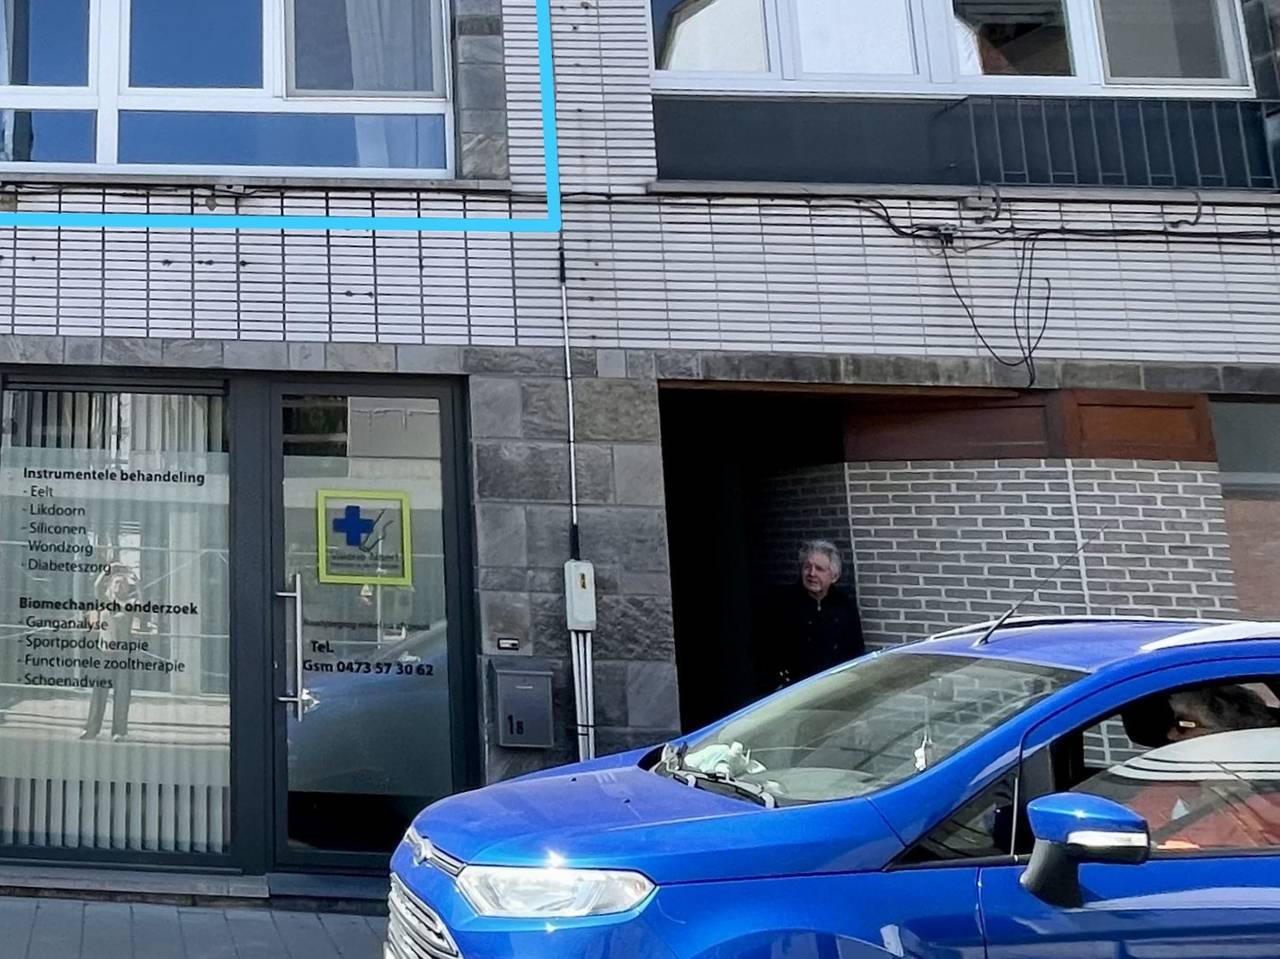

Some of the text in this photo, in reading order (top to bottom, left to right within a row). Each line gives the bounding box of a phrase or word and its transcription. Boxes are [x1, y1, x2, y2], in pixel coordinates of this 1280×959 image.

[23, 467, 205, 486] Instrumentele behandeling
[30, 486, 54, 498] Eelt
[29, 504, 86, 517] Likdoorn
[29, 522, 87, 535] Siliconen
[28, 541, 94, 557] Wondzorg
[27, 558, 112, 576] Diabeteszorg
[19, 597, 199, 615] Biomechanisch onderzoek
[25, 615, 109, 632] Ganganalyse
[25, 636, 149, 655] Sportpodotherapie
[24, 655, 186, 674] Functionele zooltherapie
[303, 659, 434, 676] Gsm 0473 57 30 62
[24, 673, 114, 689] Schoenadvies
